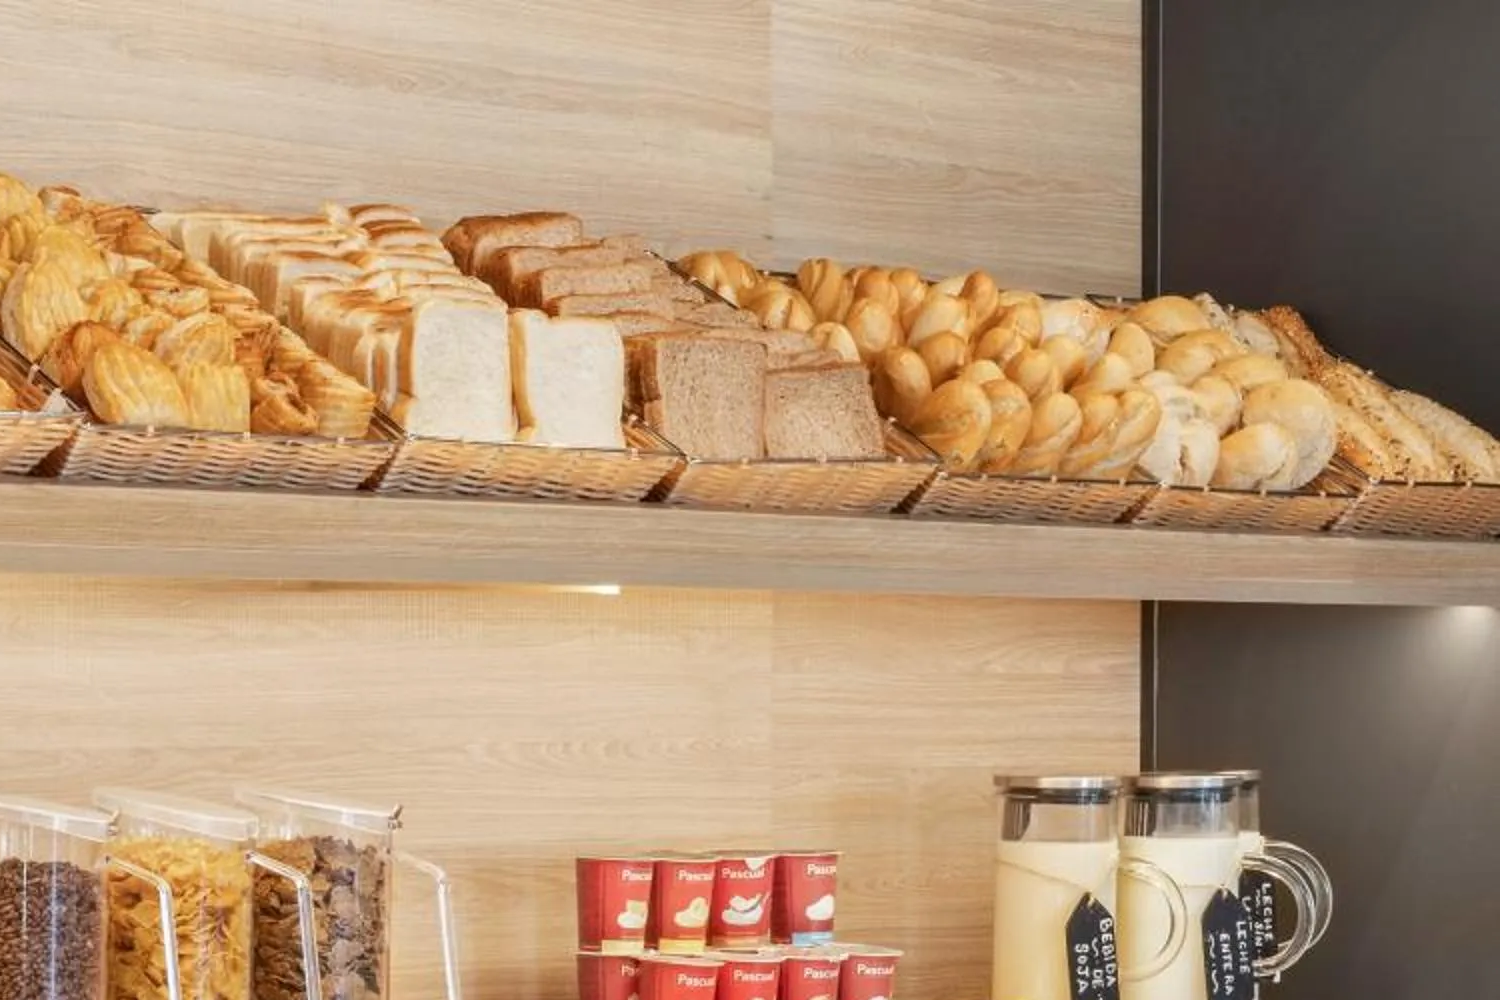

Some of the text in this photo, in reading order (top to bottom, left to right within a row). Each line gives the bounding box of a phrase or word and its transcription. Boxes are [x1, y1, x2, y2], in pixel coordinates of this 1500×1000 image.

[1075, 943, 1090, 994] SOJA
[1099, 917, 1116, 987] BEBIDA
[1219, 933, 1235, 996] ENTERA
[1236, 921, 1250, 974] LECHE
[1092, 969, 1105, 989] DE
